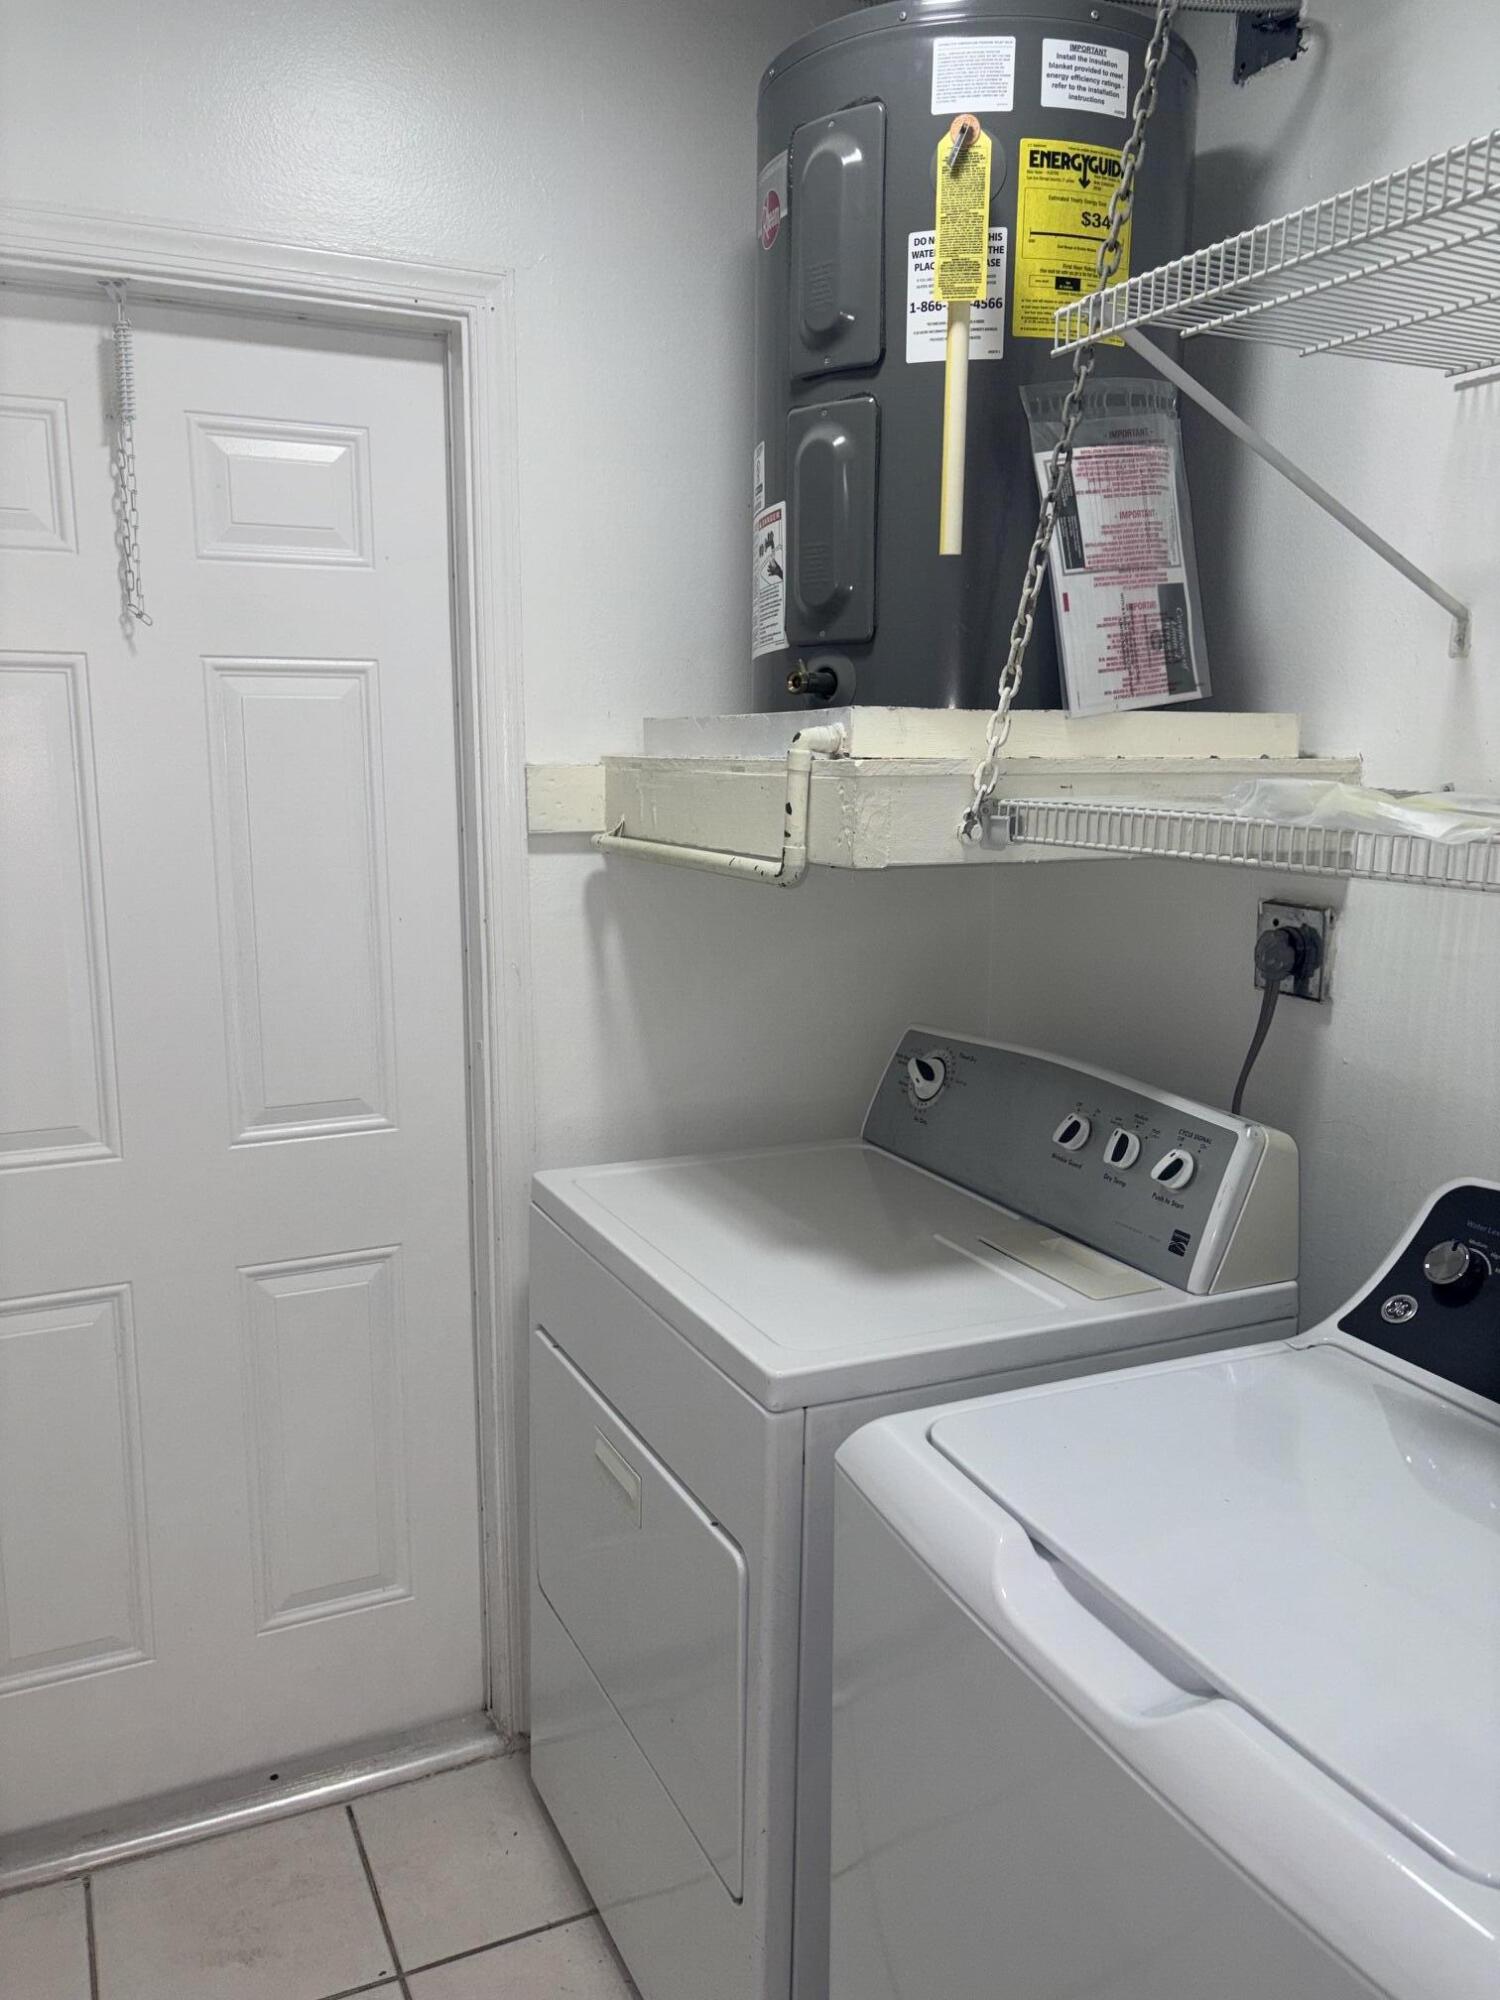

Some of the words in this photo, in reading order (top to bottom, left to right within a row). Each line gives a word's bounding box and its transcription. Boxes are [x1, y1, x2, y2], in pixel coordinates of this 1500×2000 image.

[1069, 44, 1108, 58] IMPORTANT
[1056, 53, 1077, 61] Install
[1077, 55, 1088, 63] the
[1088, 57, 1118, 69] insulation
[1048, 62, 1073, 71] blanket
[1074, 65, 1102, 76] provided
[1109, 72, 1124, 80] meet
[1046, 73, 1070, 81] energy
[1070, 74, 1100, 86] efficiency
[1101, 80, 1121, 90] ratings
[1051, 82, 1067, 90] refer
[1087, 86, 1120, 99] installation
[1068, 93, 1105, 106] instructions
[1029, 149, 1123, 183] ENERGYGUID
[1081, 210, 1112, 230] $34
[914, 238, 927, 247] DO
[988, 232, 1003, 242] HIS
[911, 249, 935, 260] WATE
[914, 261, 935, 272] PLAC
